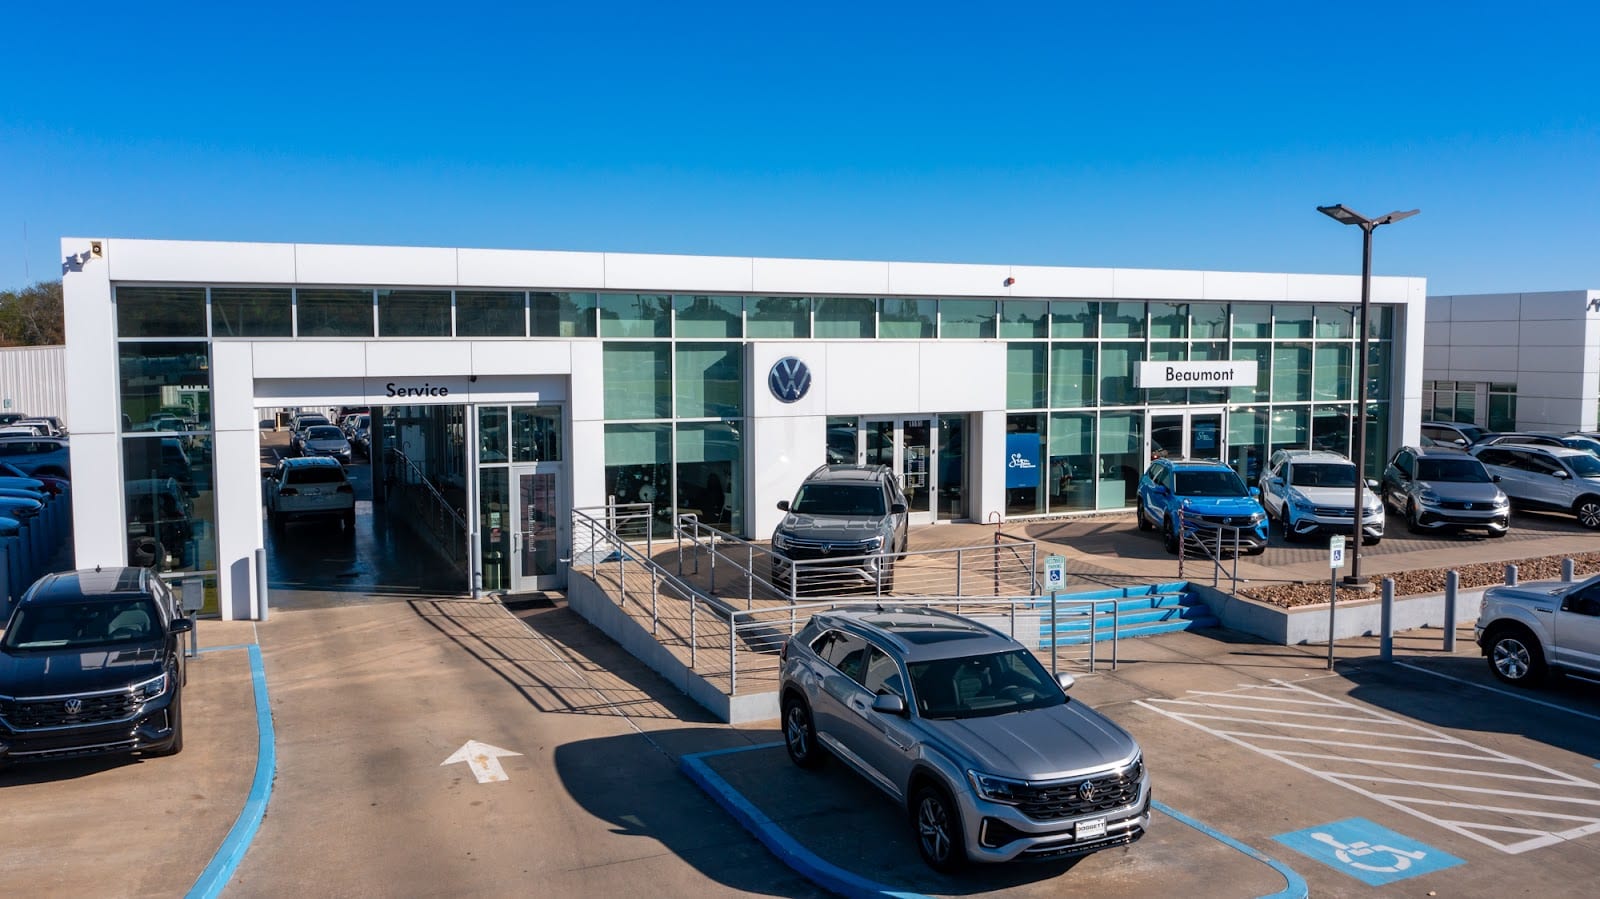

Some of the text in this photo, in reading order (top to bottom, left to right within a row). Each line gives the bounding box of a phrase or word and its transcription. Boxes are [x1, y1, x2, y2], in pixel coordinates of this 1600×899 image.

[769, 357, 811, 402] VW
[1166, 366, 1234, 381] Beaumont
[386, 383, 449, 397] Service
